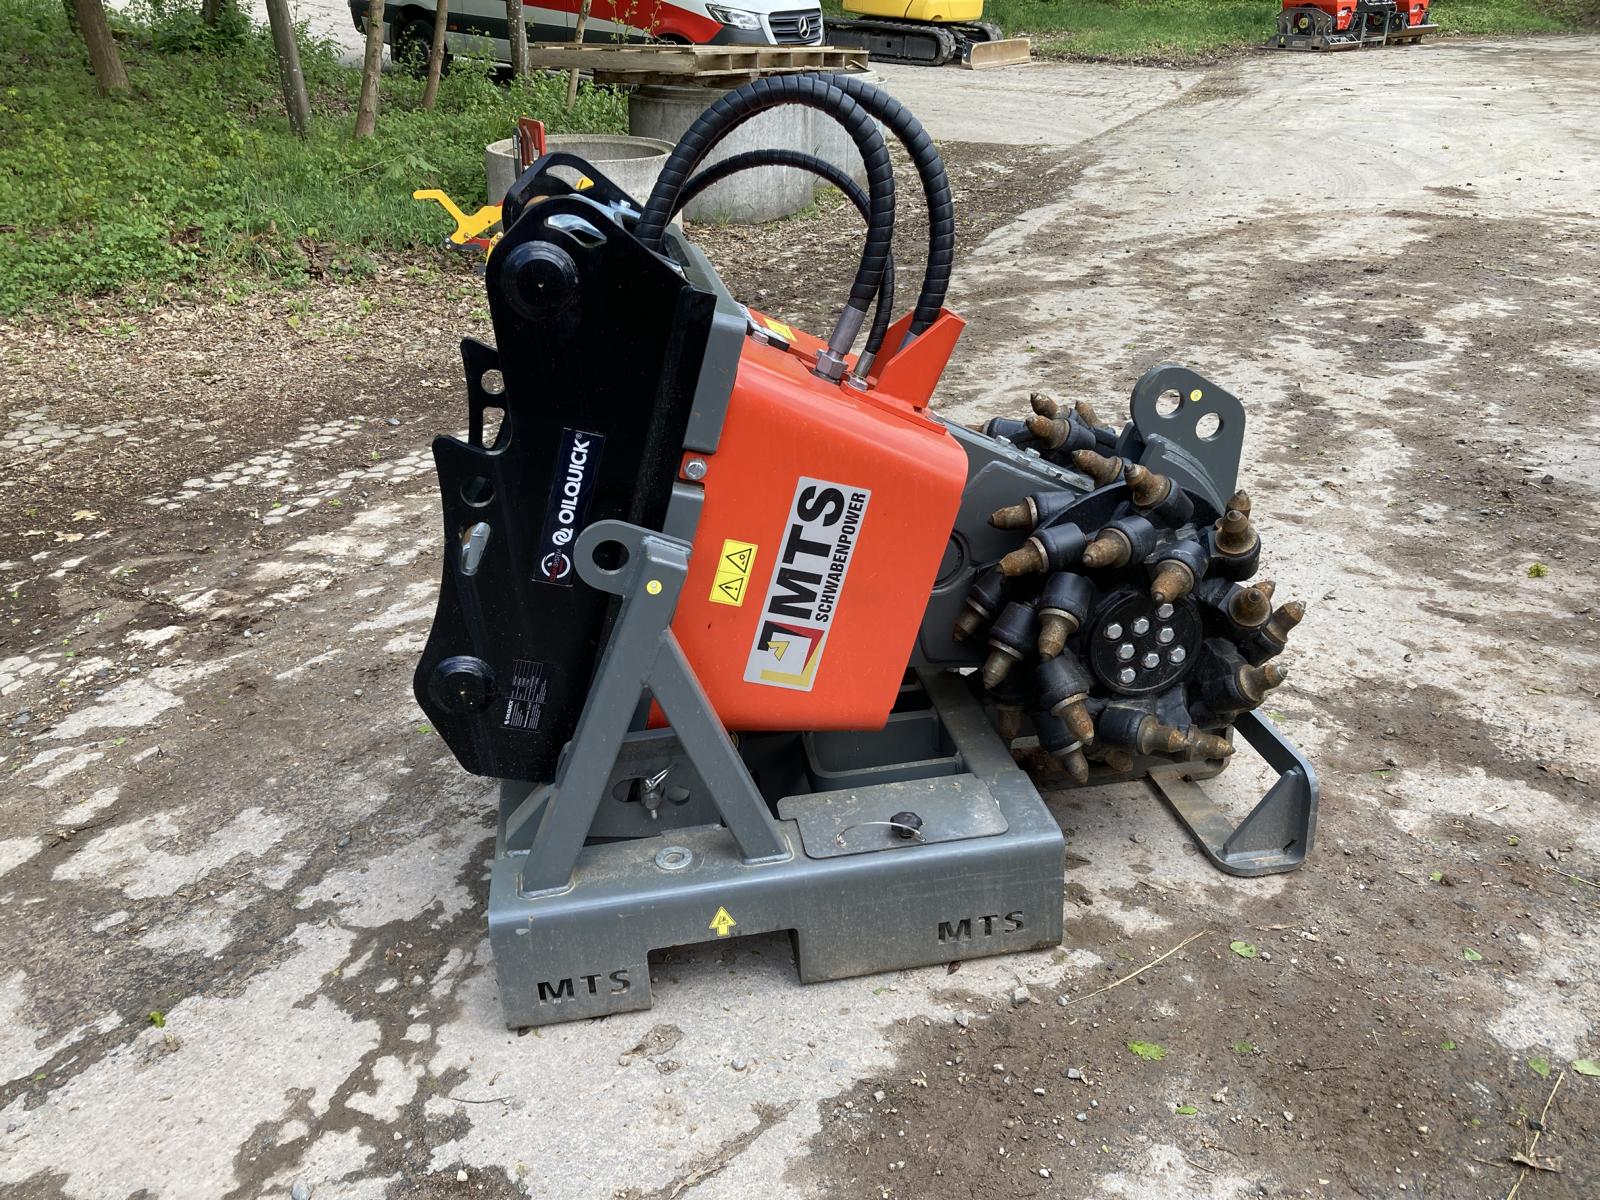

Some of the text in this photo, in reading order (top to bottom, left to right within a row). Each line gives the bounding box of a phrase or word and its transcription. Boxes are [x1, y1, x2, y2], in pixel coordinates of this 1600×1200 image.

[767, 485, 846, 620] MTS
[815, 492, 867, 622] SCHWABENPOWER
[938, 911, 1024, 944] MTS
[536, 969, 632, 1005] MTS
